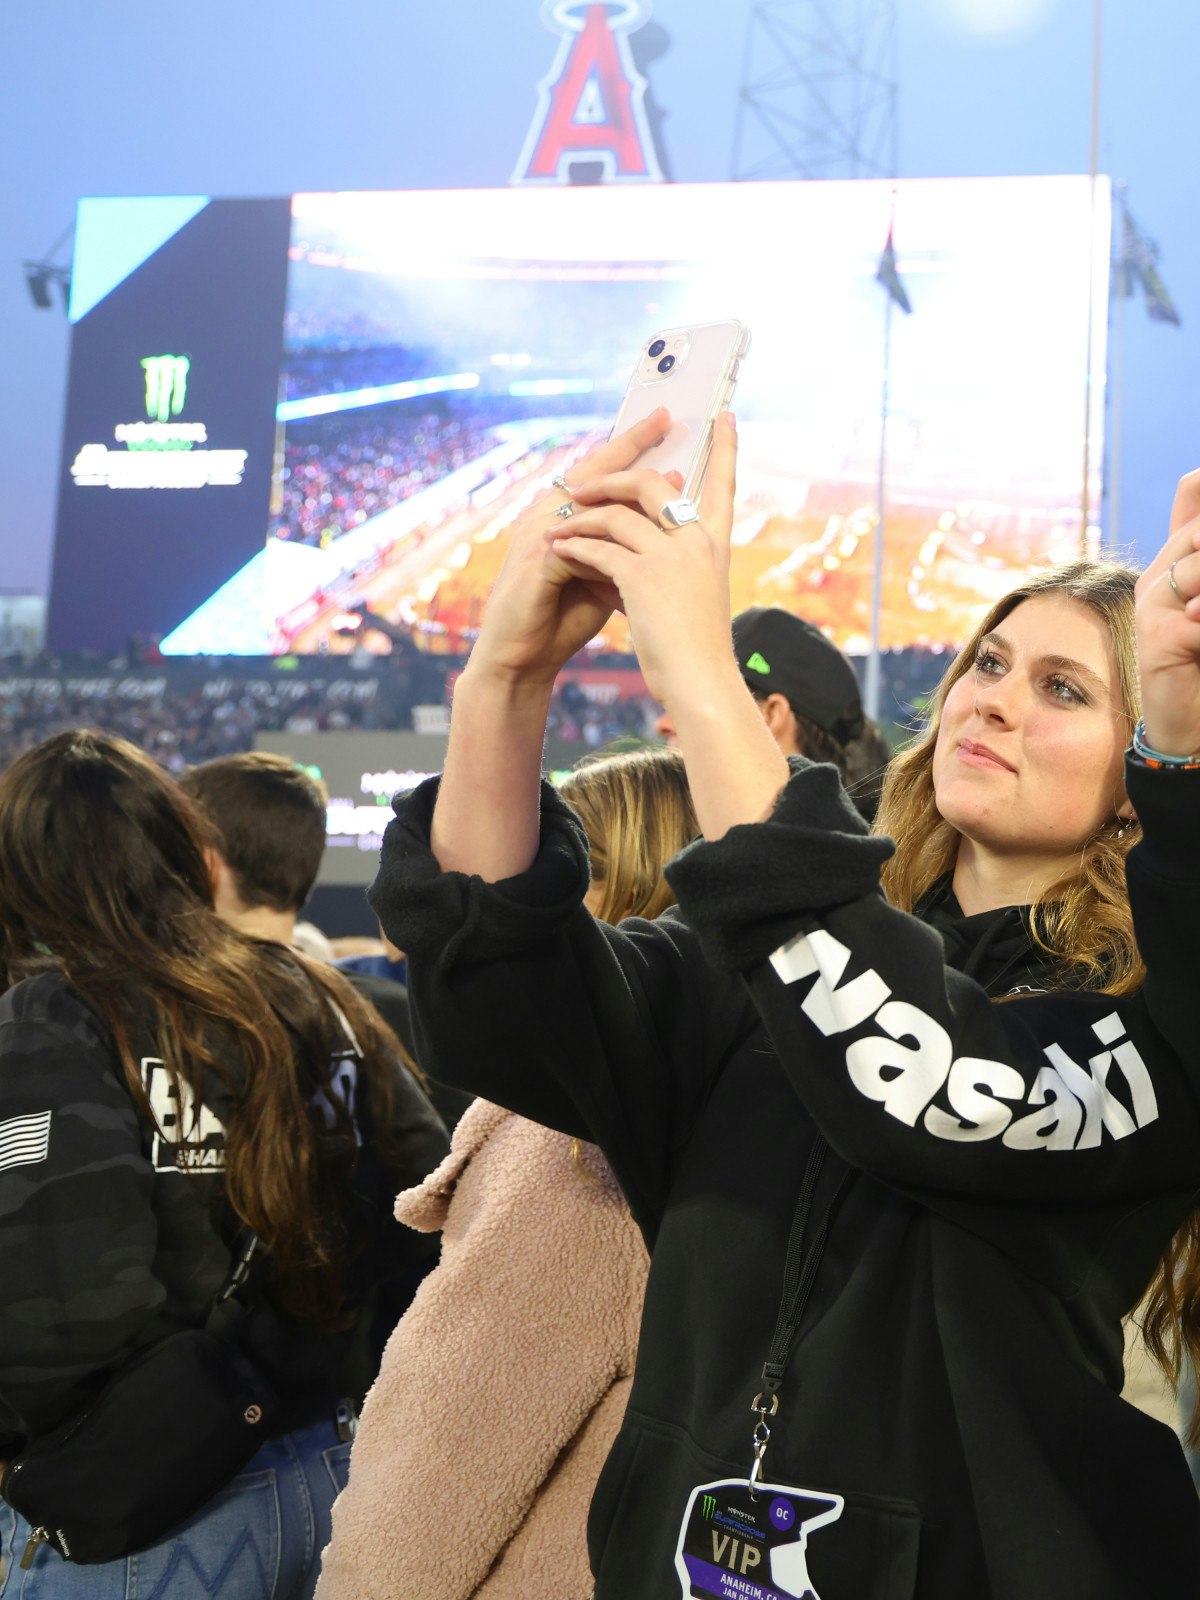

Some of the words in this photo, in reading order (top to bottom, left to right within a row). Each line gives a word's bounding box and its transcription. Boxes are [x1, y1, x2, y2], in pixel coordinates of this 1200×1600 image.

[776, 1507, 789, 1521] OC
[711, 1529, 762, 1575] VIP
[720, 1573, 764, 1600] ANAHEIM,
[723, 1587, 738, 1600] JAN
